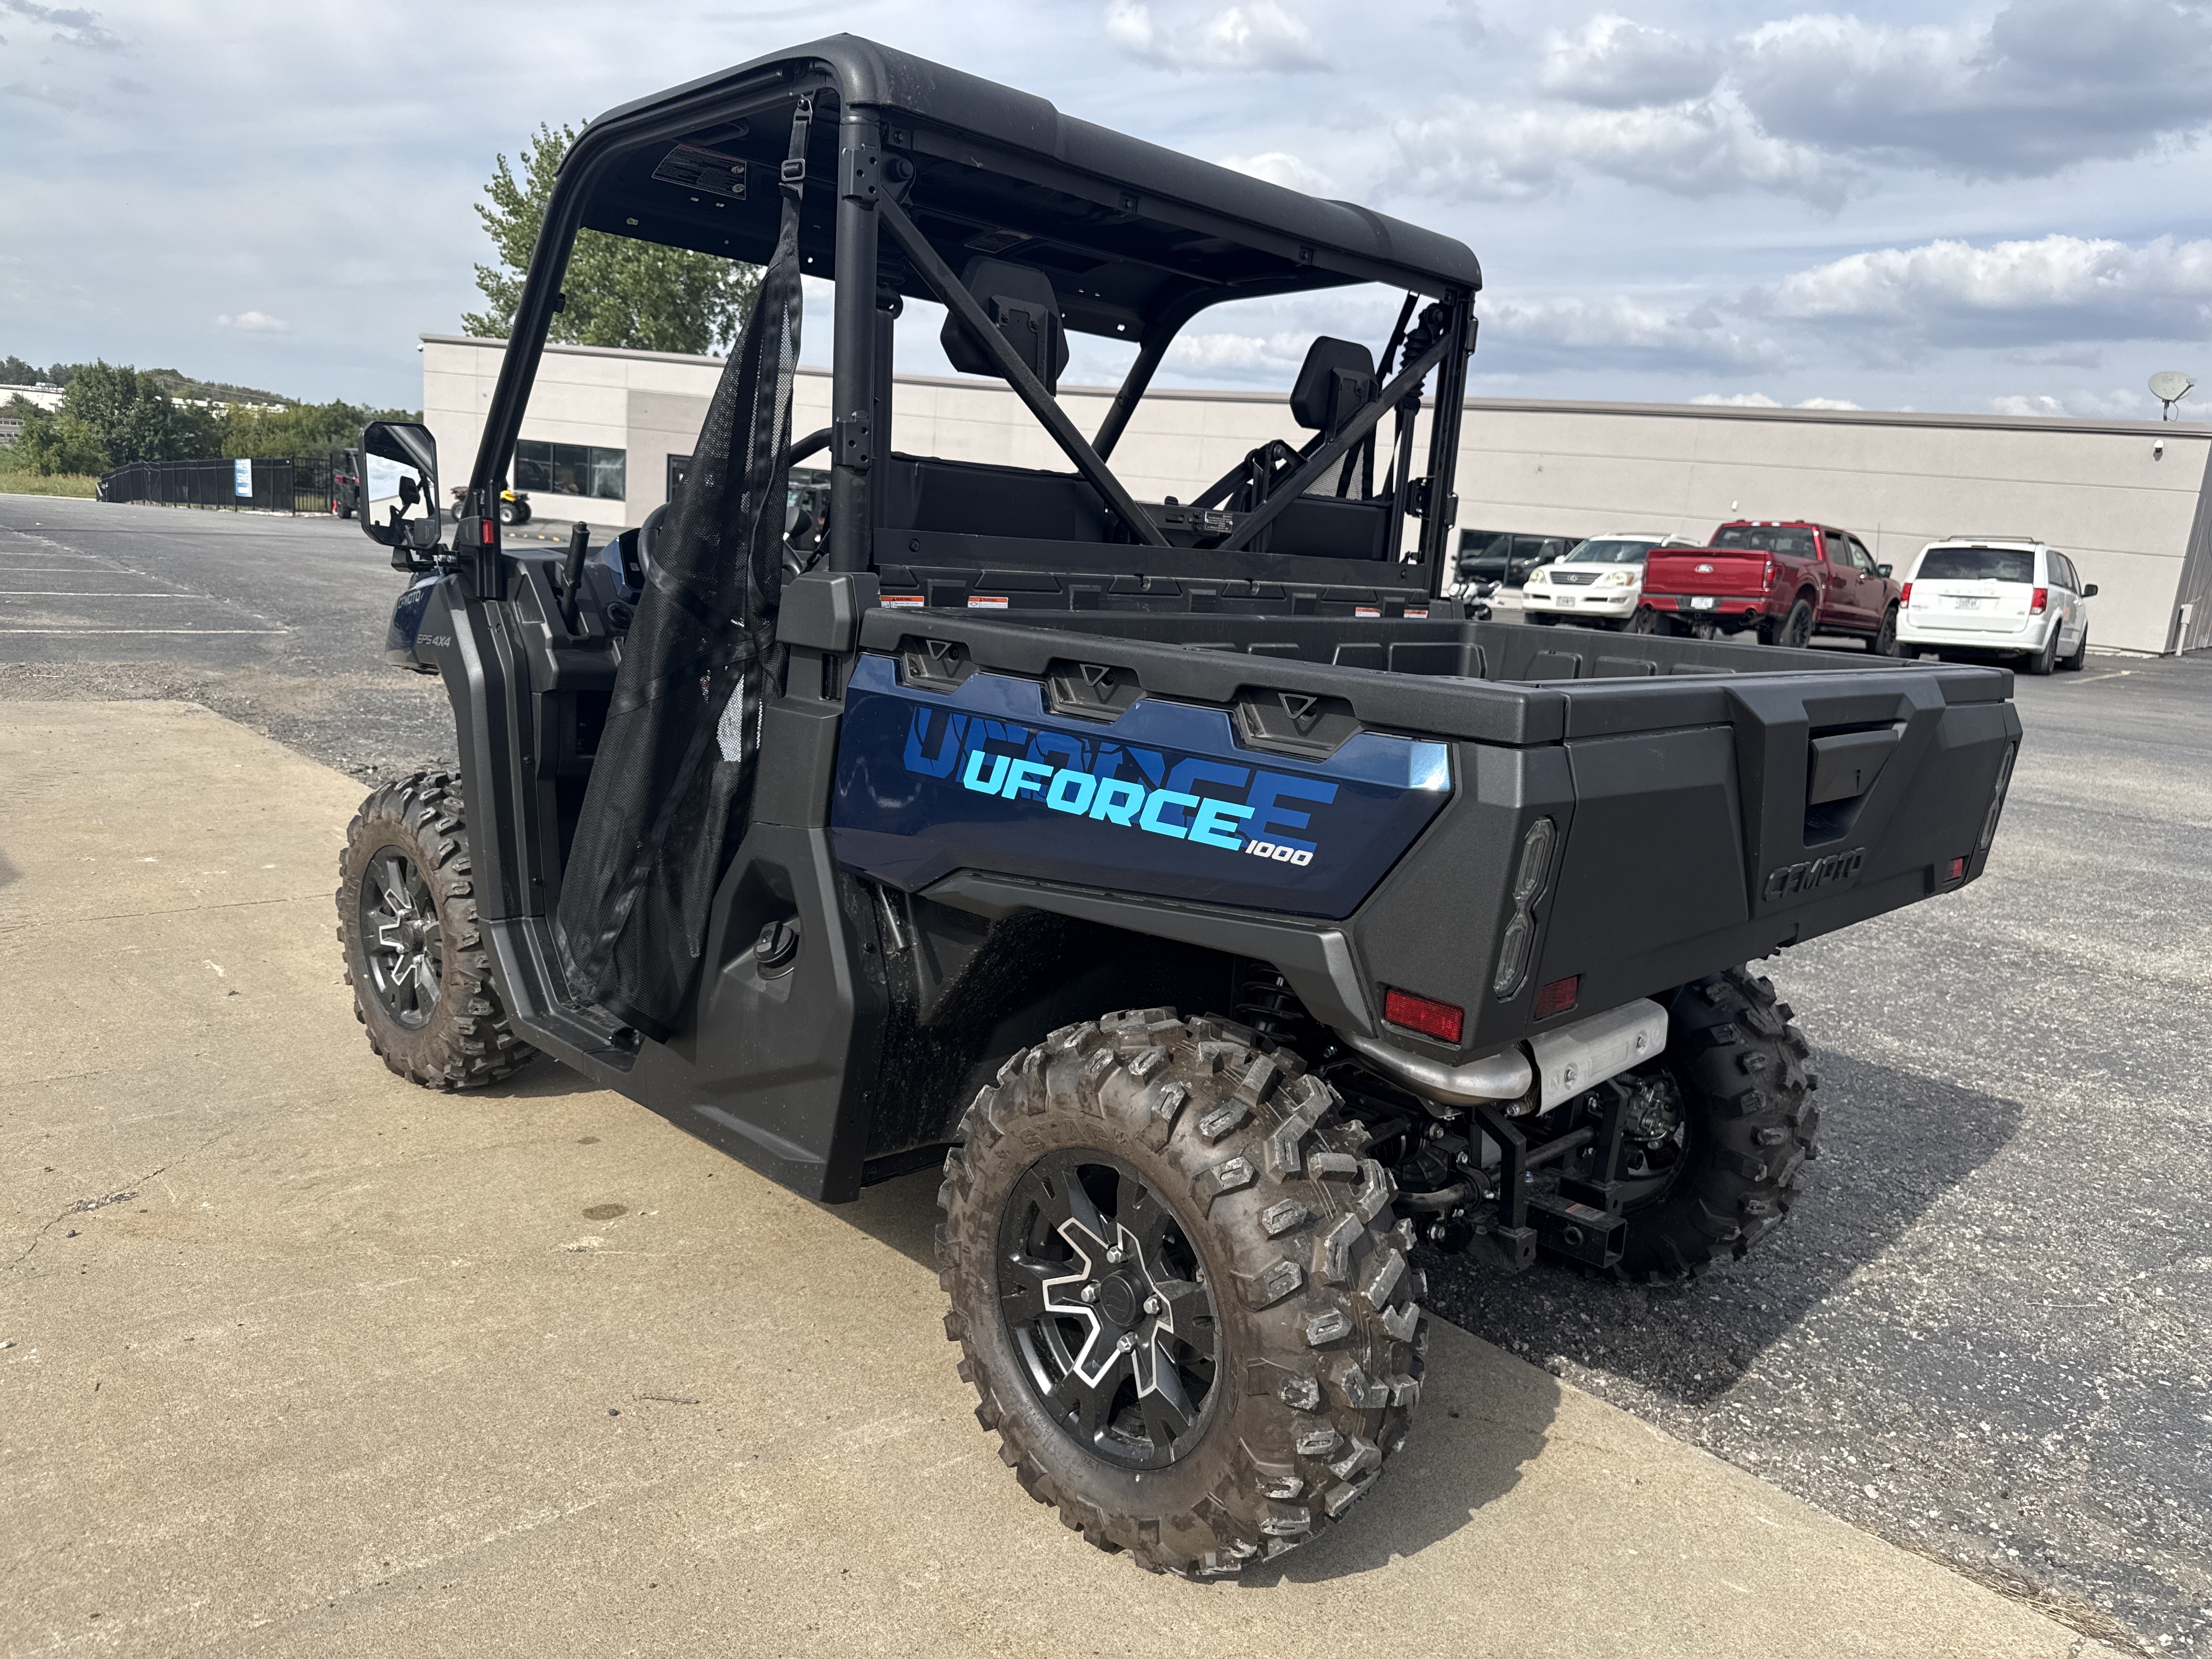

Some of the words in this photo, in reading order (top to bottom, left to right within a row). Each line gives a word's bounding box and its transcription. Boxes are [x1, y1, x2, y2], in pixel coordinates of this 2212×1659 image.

[417, 634, 432, 645] EPS
[432, 636, 451, 647] 4X4
[963, 749, 1255, 850] UFORCE
[1245, 839, 1313, 866] 1000
[1764, 847, 1865, 901] CFMOTO
